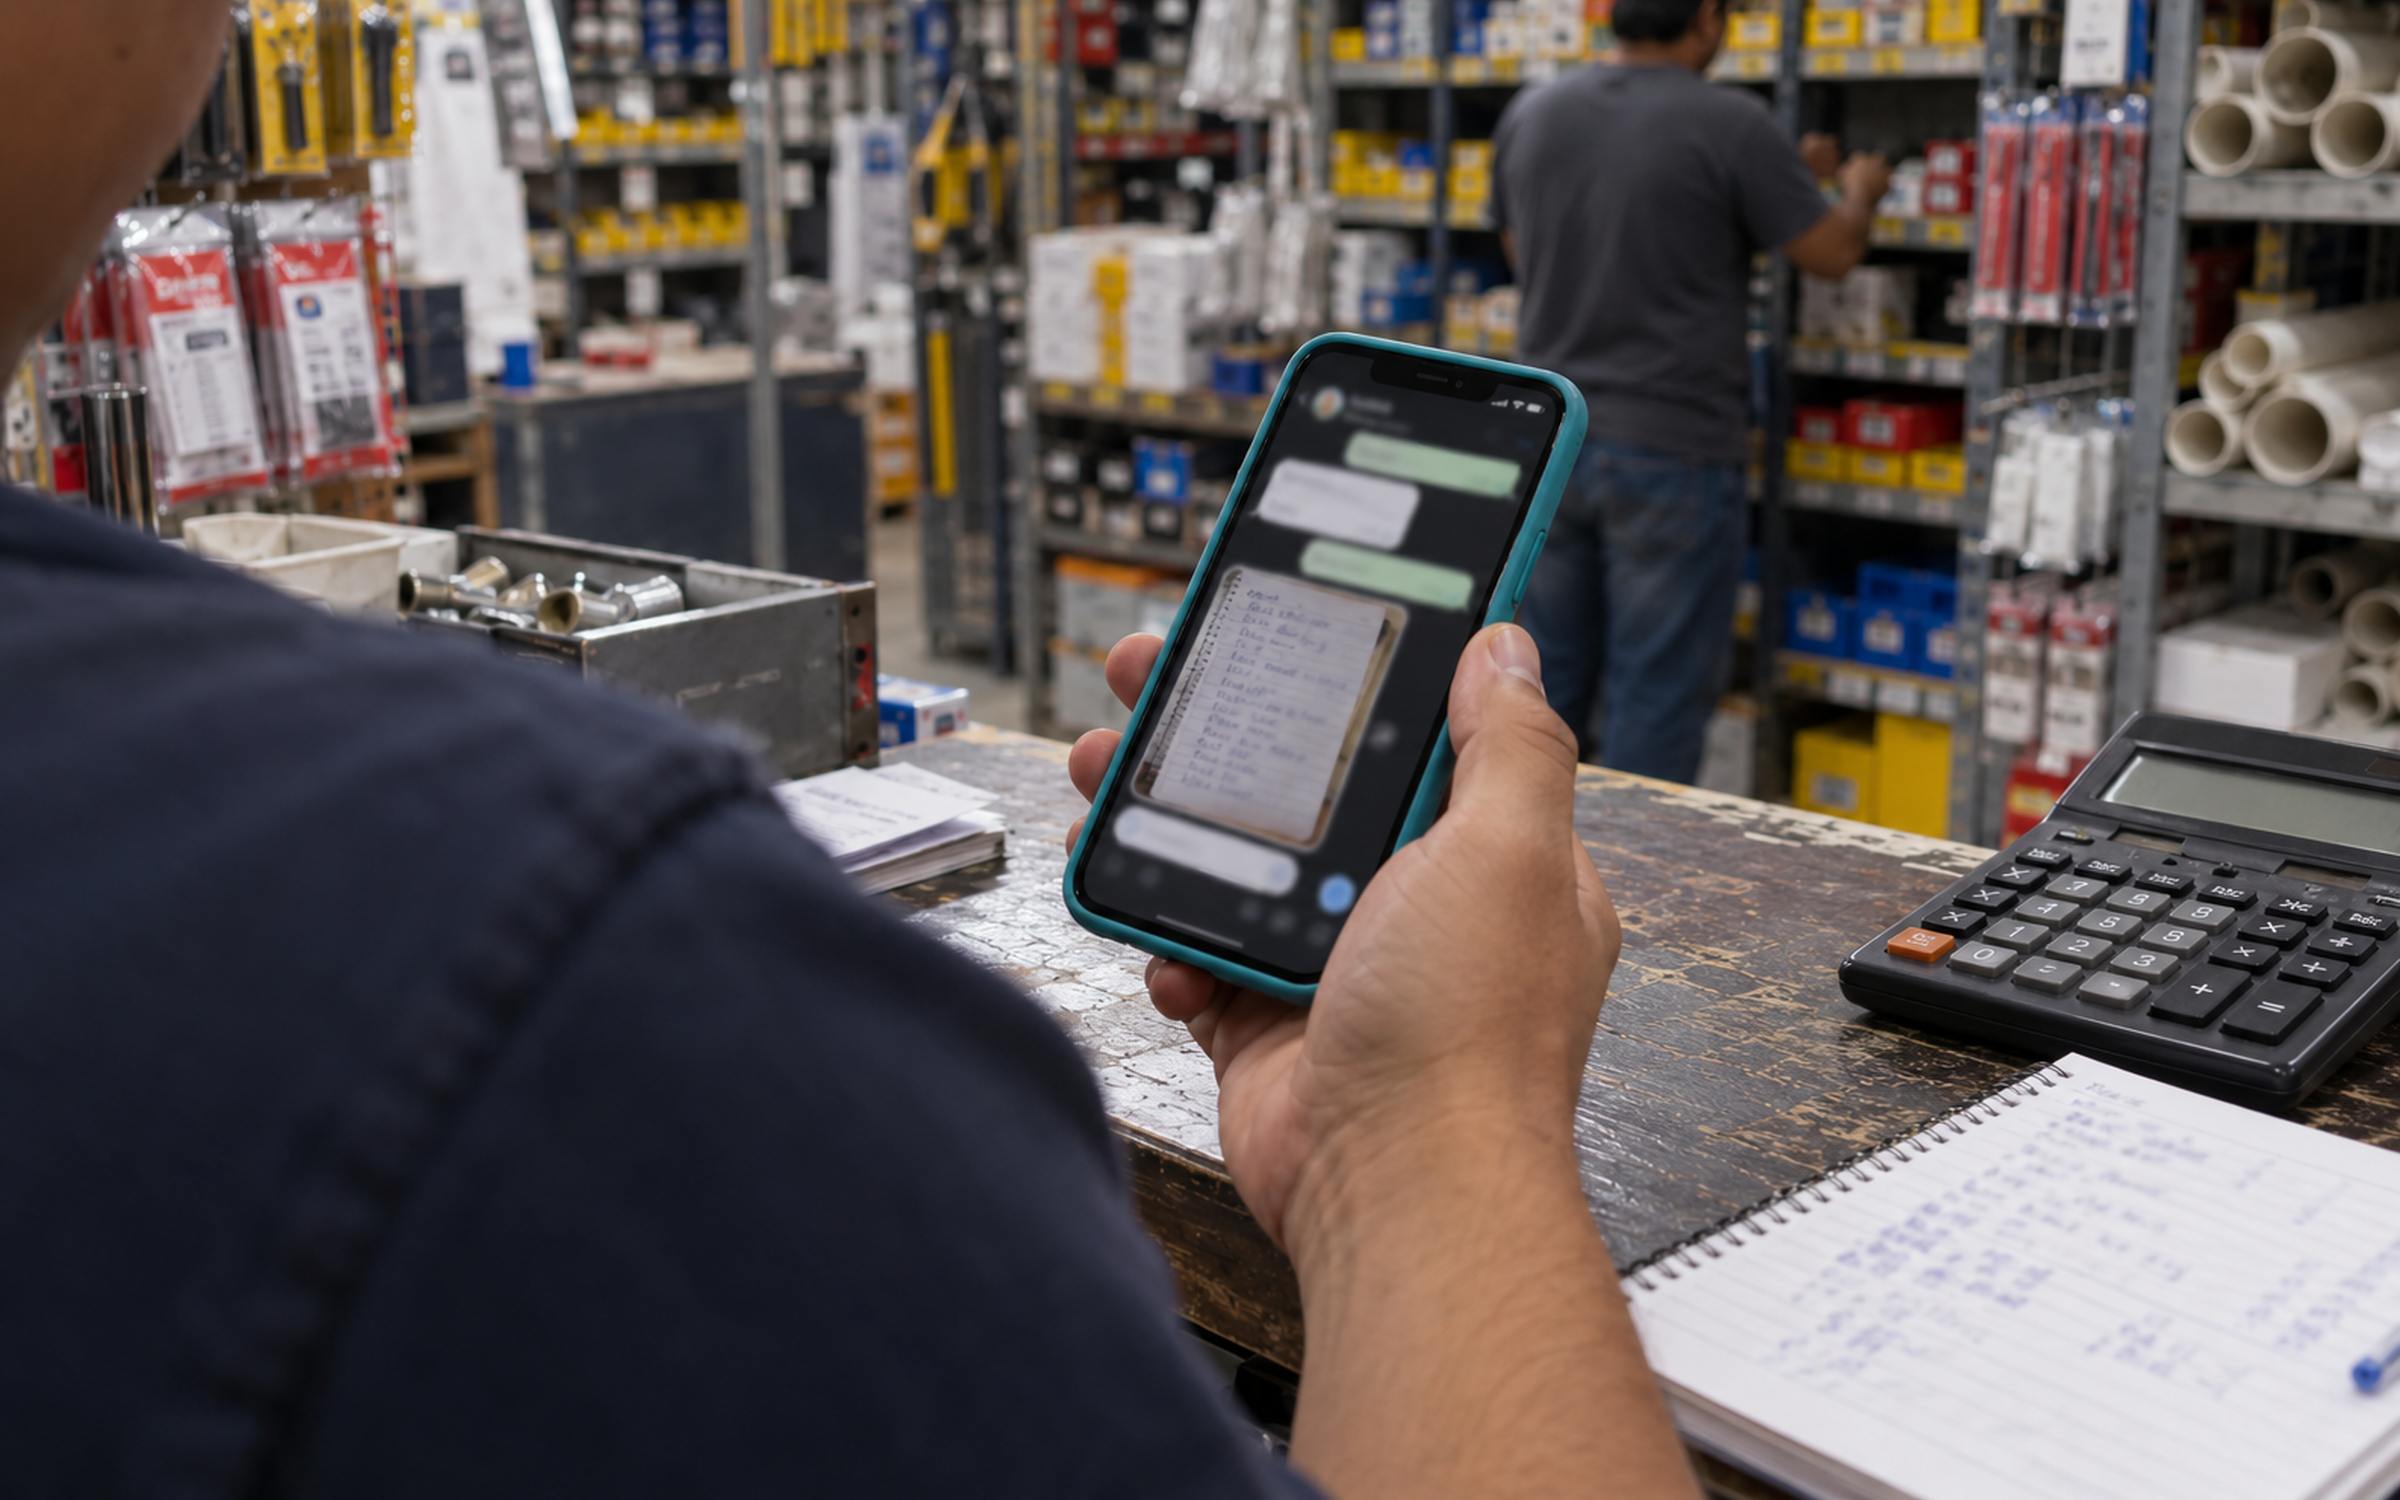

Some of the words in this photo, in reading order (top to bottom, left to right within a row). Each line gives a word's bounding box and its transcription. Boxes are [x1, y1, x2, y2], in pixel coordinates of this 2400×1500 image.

[2009, 926, 2025, 938] 1
[2067, 939, 2090, 952] 2
[1973, 948, 1996, 961] 0
[2133, 954, 2156, 967] 3
